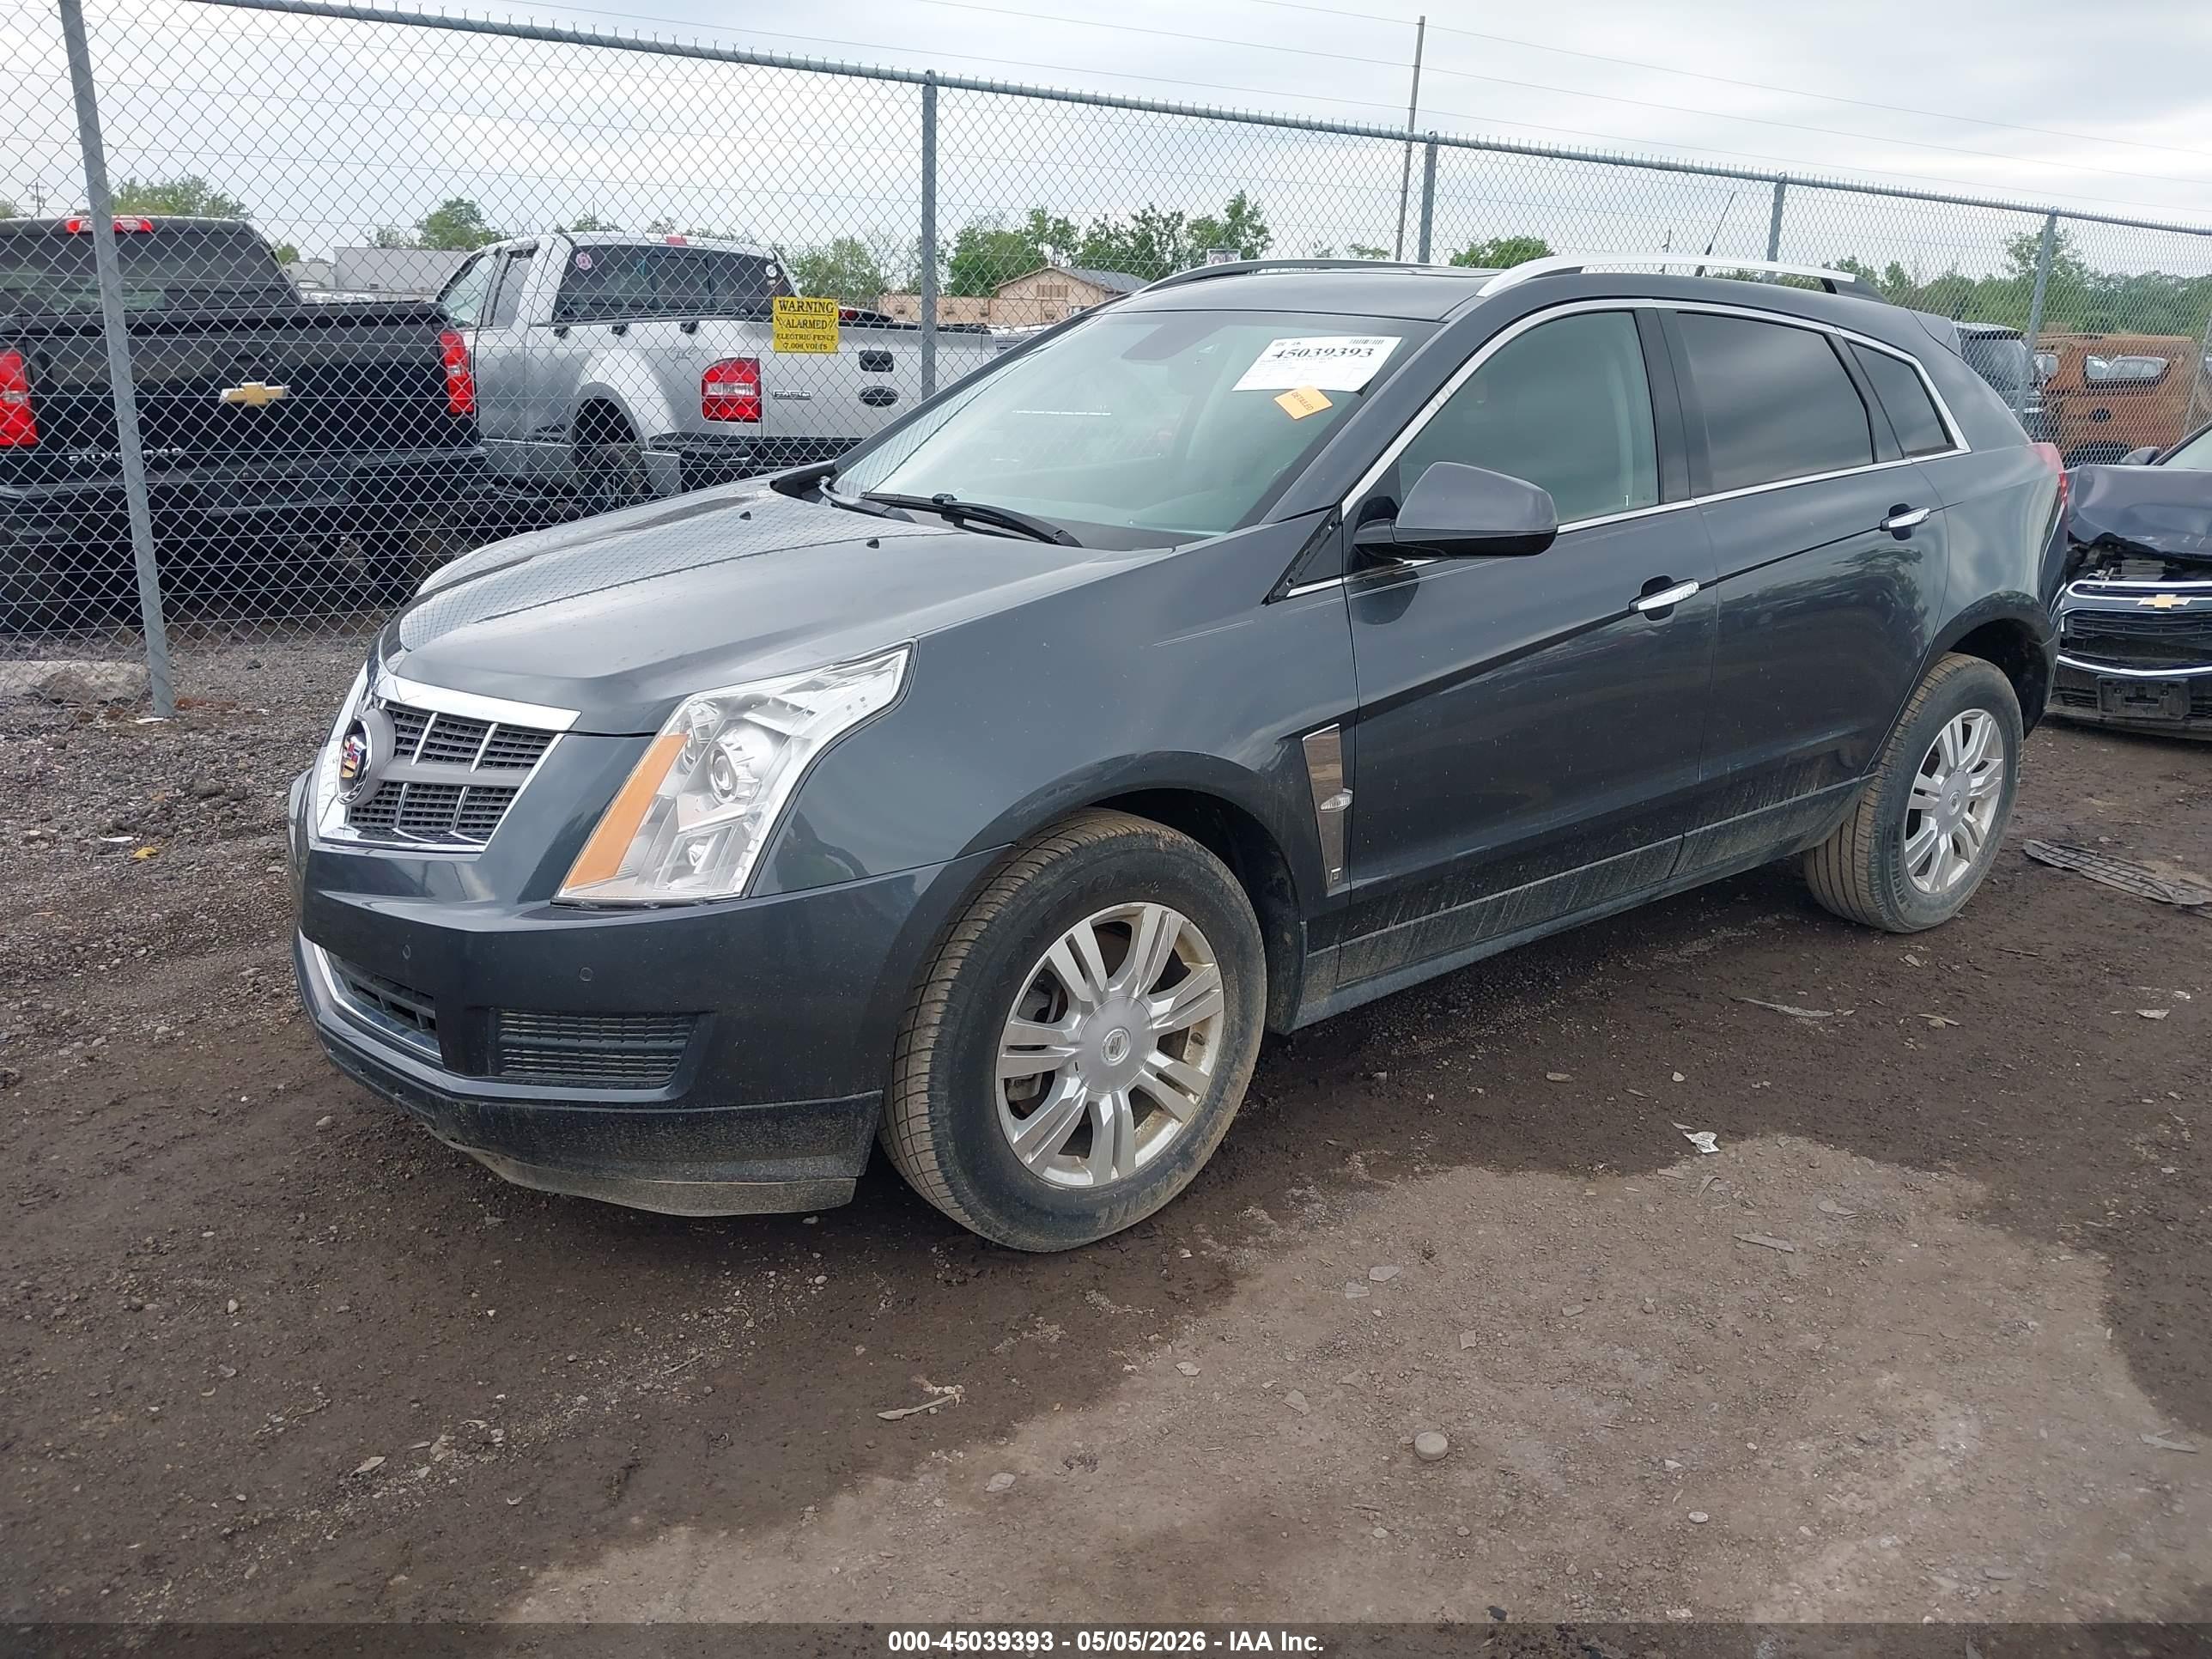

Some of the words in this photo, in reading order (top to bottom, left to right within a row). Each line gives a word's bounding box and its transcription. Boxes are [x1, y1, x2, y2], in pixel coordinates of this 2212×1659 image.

[778, 300, 835, 313] WARNING
[786, 319, 828, 330] ALARMED
[1272, 347, 1374, 358] 45039393
[1291, 392, 1315, 411] DETAILED
